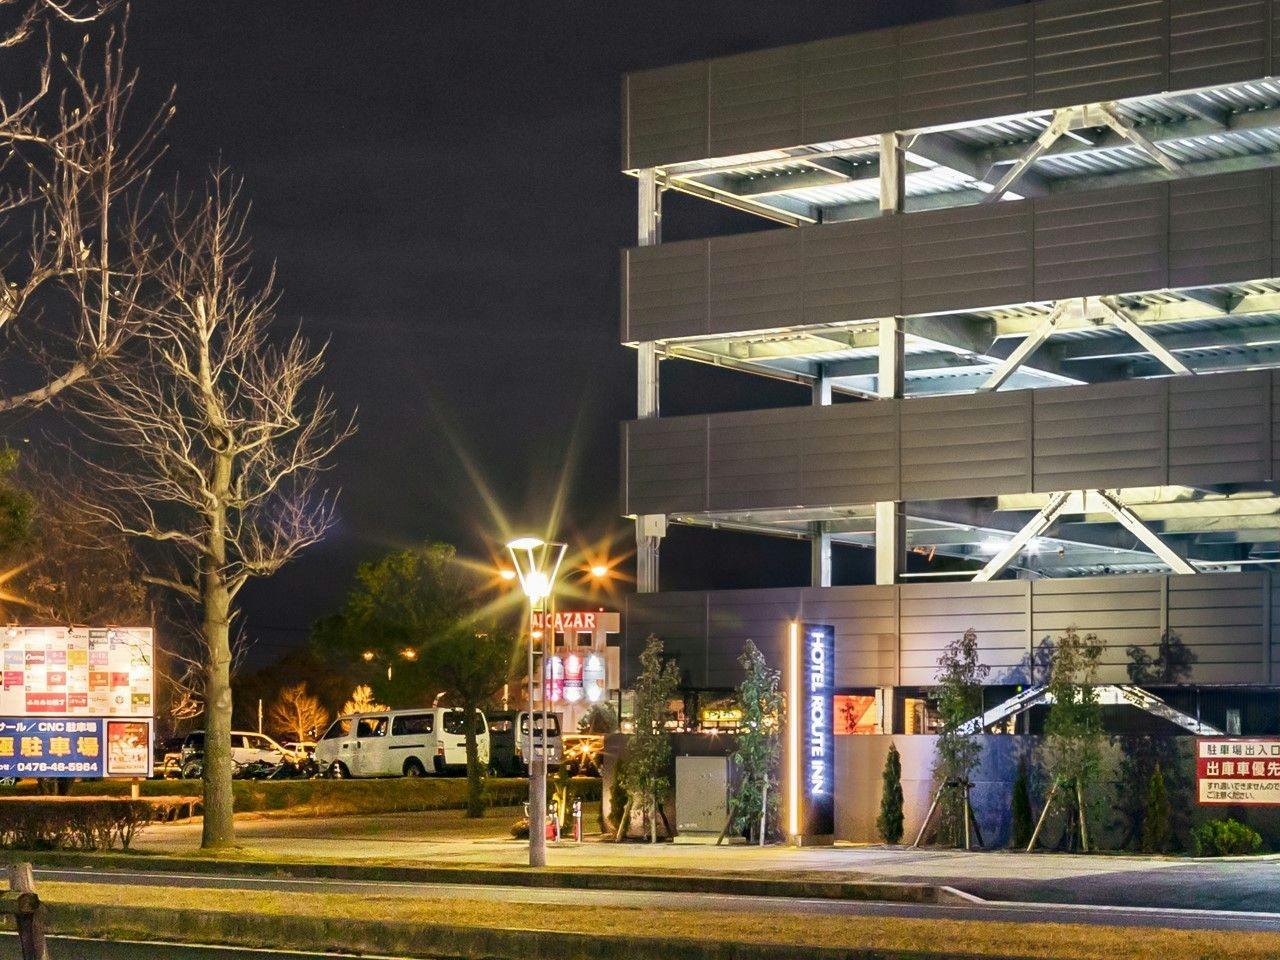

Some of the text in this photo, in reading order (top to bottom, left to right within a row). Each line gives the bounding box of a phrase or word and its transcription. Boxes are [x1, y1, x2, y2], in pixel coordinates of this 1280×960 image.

[811, 632, 825, 794] HOTEL ROUTE INN
[1207, 744, 1280, 756] 駐車場出入口
[1206, 760, 1280, 776] 出庫車優先
